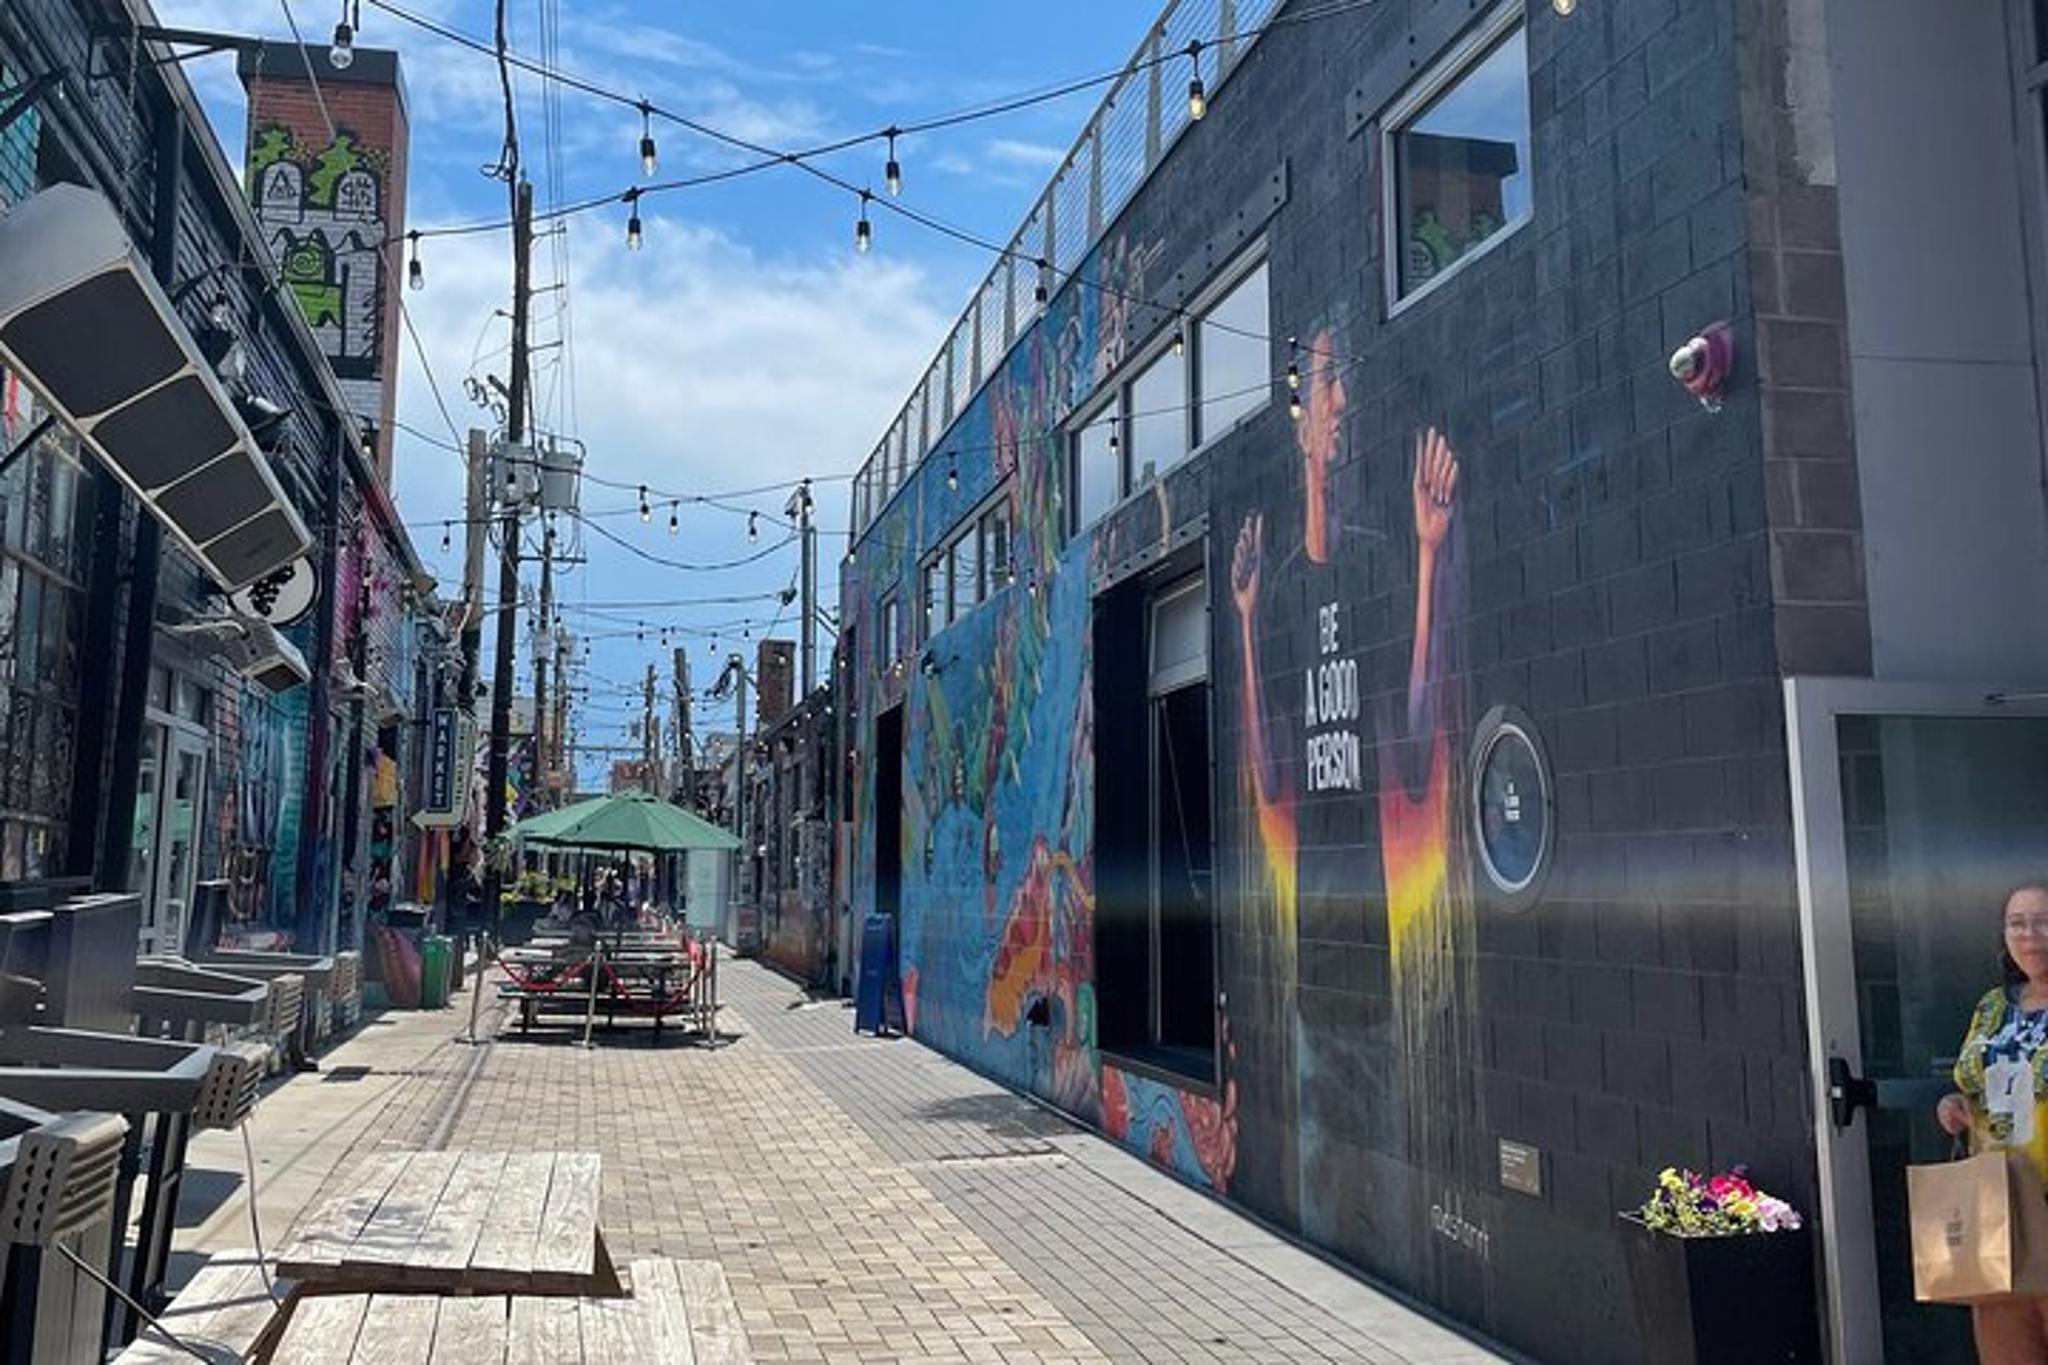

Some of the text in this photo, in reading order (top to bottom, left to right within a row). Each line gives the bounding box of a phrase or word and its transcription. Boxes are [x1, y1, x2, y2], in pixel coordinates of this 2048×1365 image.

[1319, 602, 1338, 654] BE
[1305, 660, 1359, 728] A GOOD
[434, 714, 448, 805] MARKET
[1307, 730, 1361, 790] PERSON
